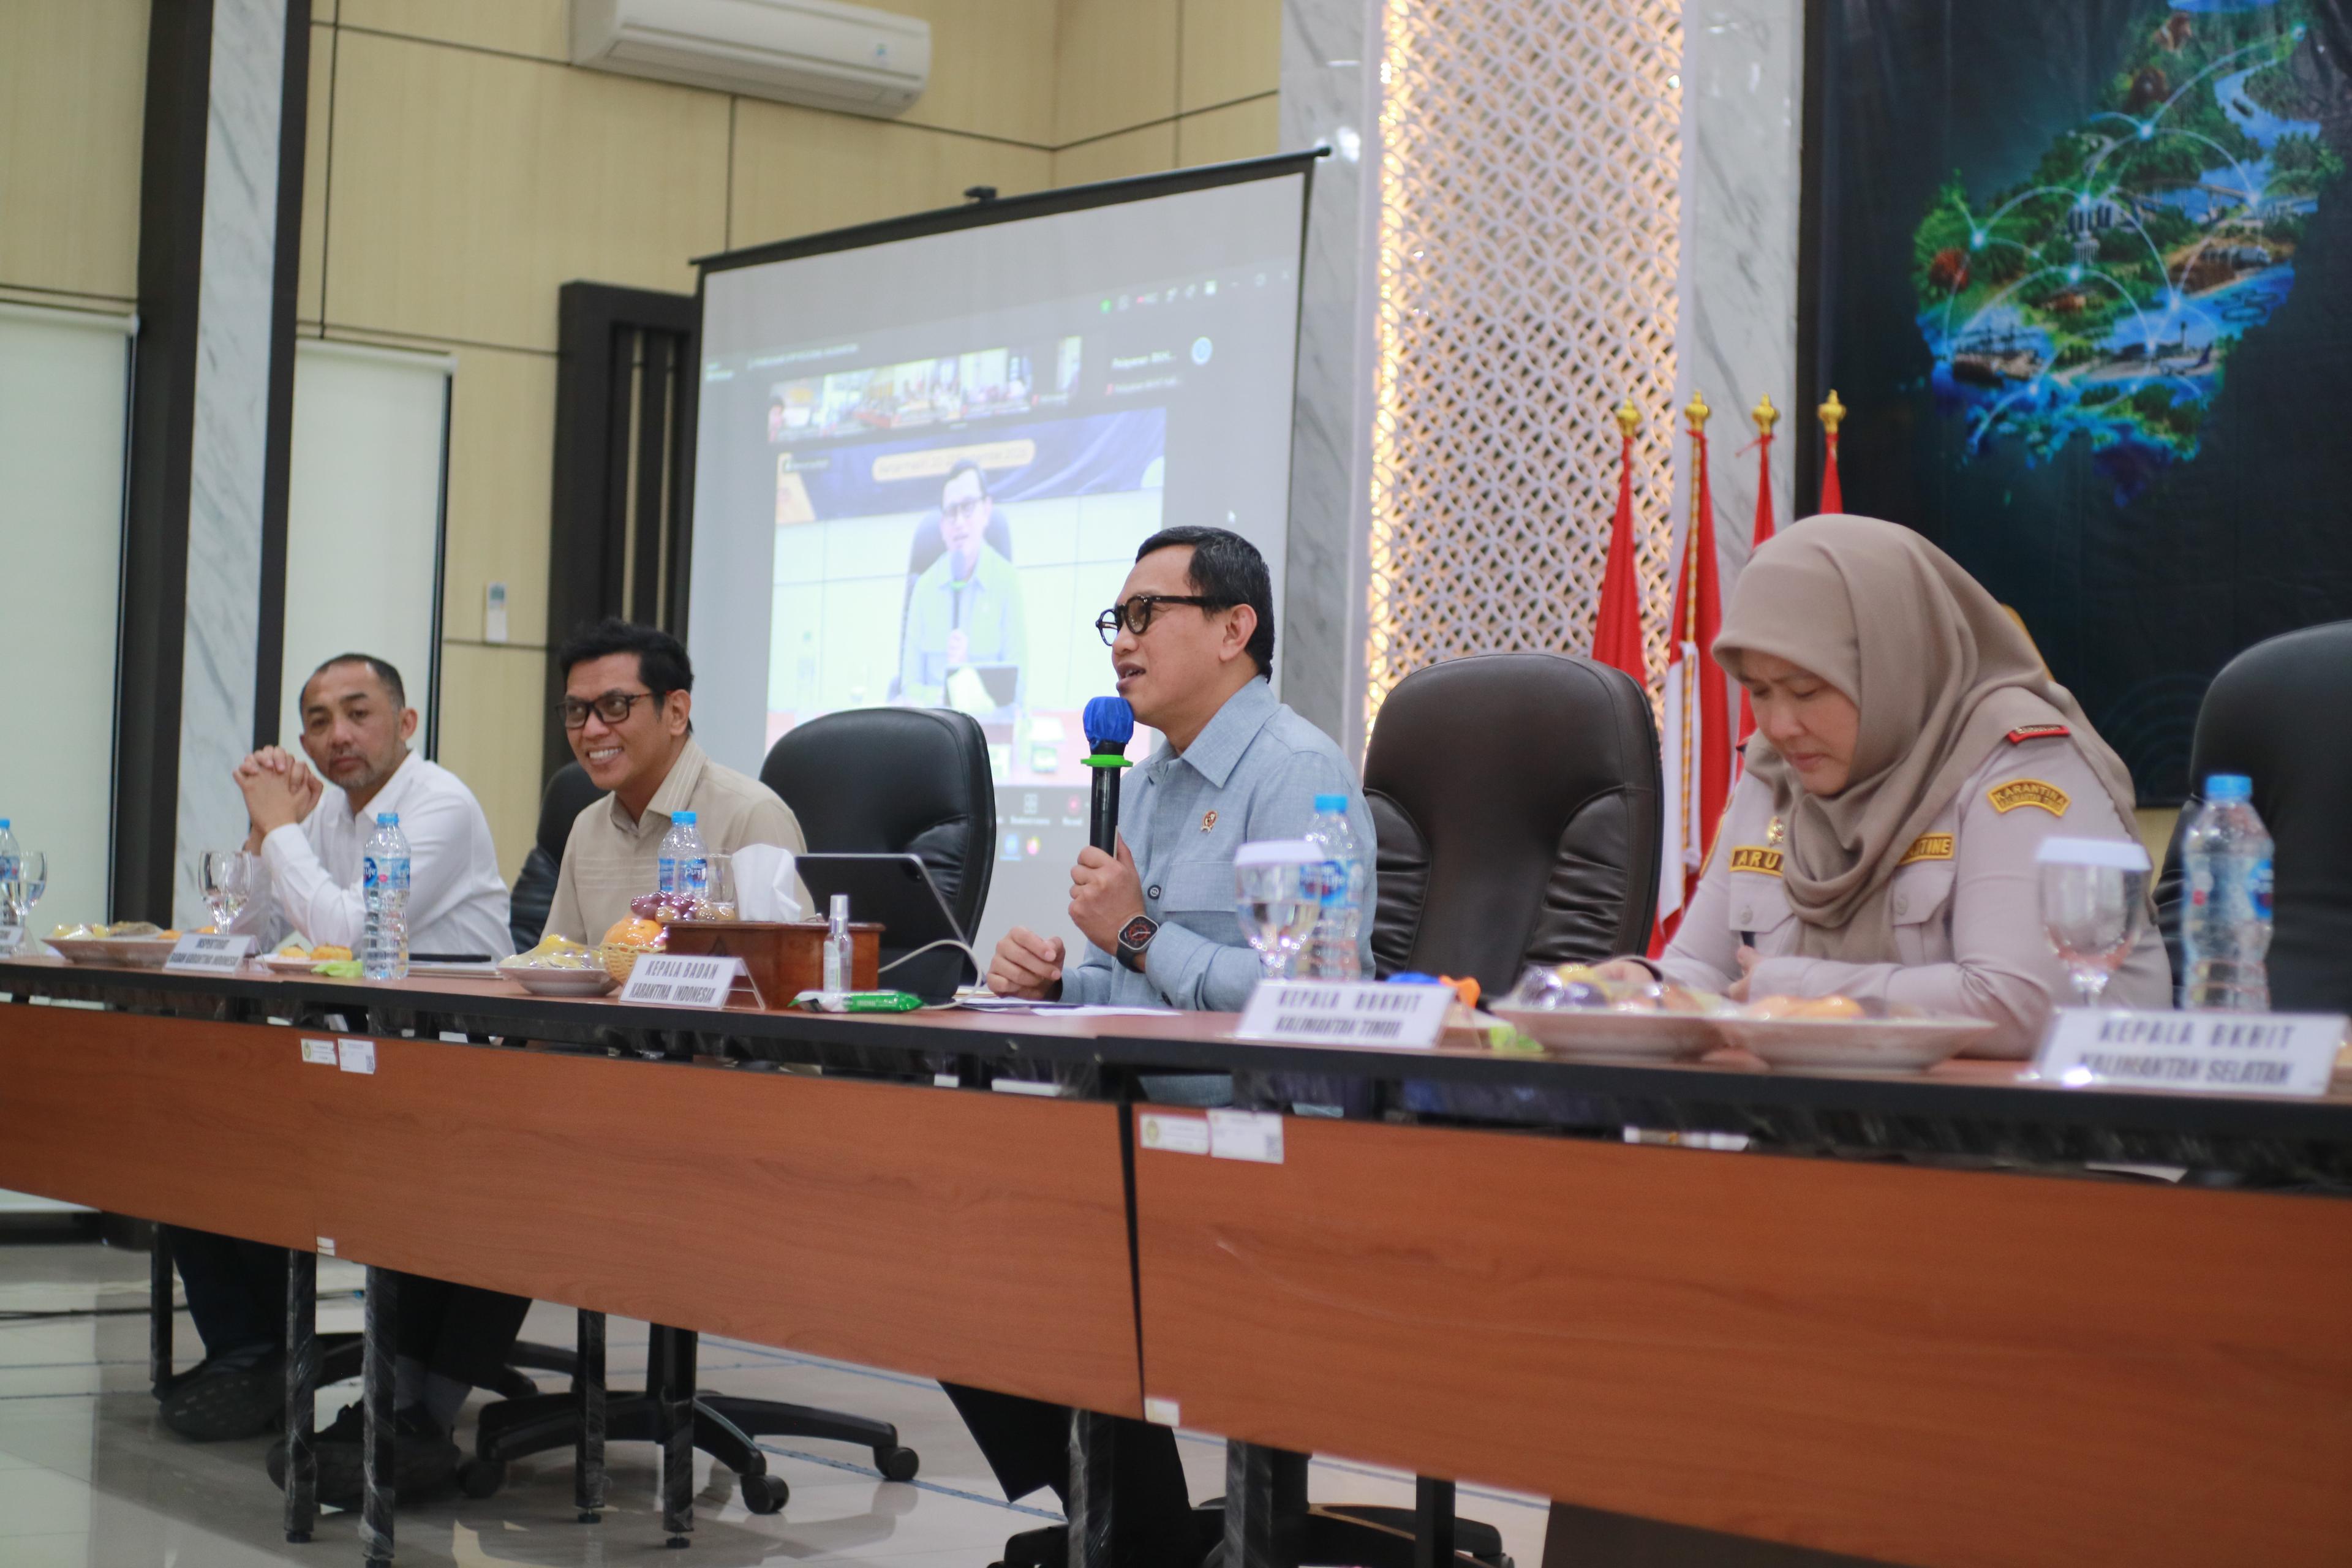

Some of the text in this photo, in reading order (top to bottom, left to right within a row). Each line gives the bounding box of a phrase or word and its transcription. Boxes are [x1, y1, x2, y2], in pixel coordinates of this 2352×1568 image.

[1994, 783, 2065, 805] KARANTINA
[1737, 850, 1784, 871] ARU
[645, 960, 719, 980] KEPALA BADAN
[628, 982, 715, 1004] KARANTINA INDONESIA
[1280, 990, 1341, 1008] KEPALA
[2100, 1021, 2193, 1042] KEPALA
[2207, 1060, 2294, 1085] SELATAN
